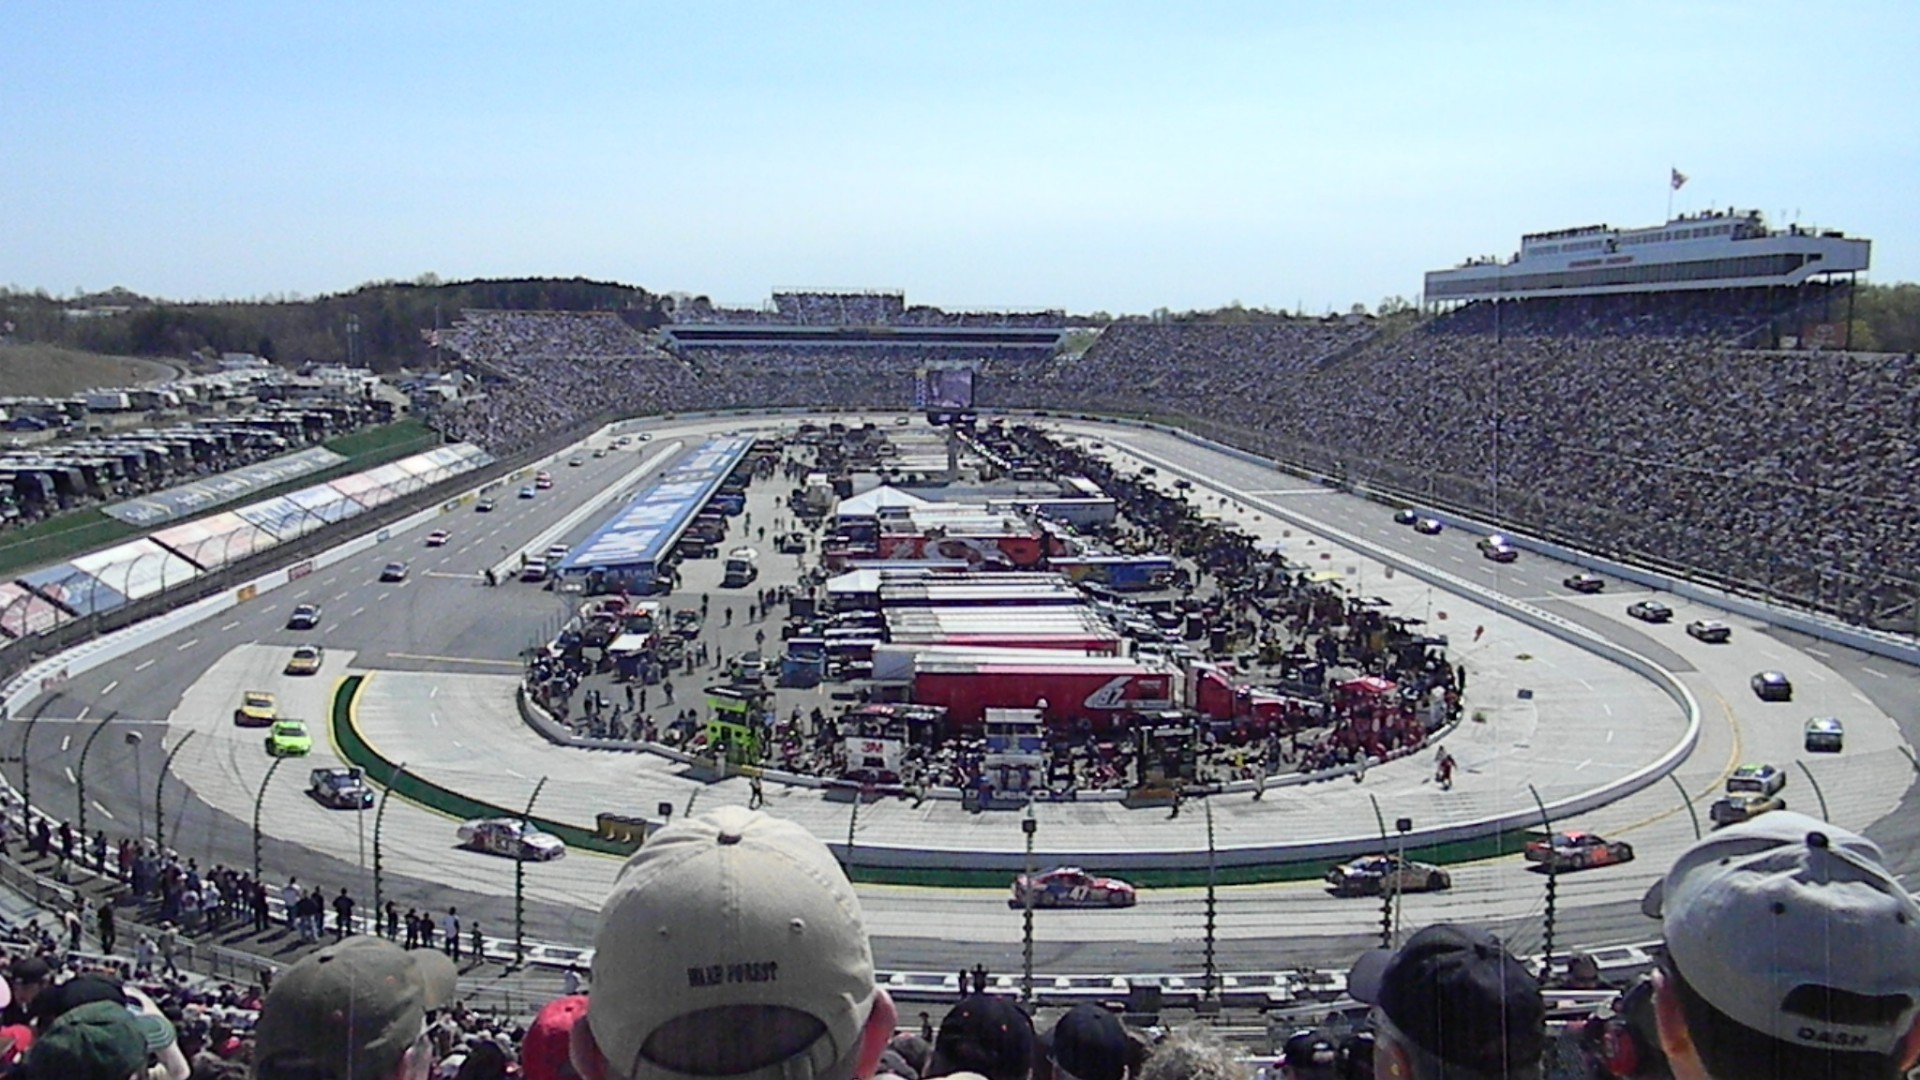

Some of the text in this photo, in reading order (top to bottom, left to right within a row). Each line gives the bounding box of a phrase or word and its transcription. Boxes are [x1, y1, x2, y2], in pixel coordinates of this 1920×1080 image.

[861, 741, 884, 753] 3M
[1069, 885, 1090, 901] 47
[727, 960, 778, 983] FOREST
[1797, 1026, 1868, 1046] DASH
